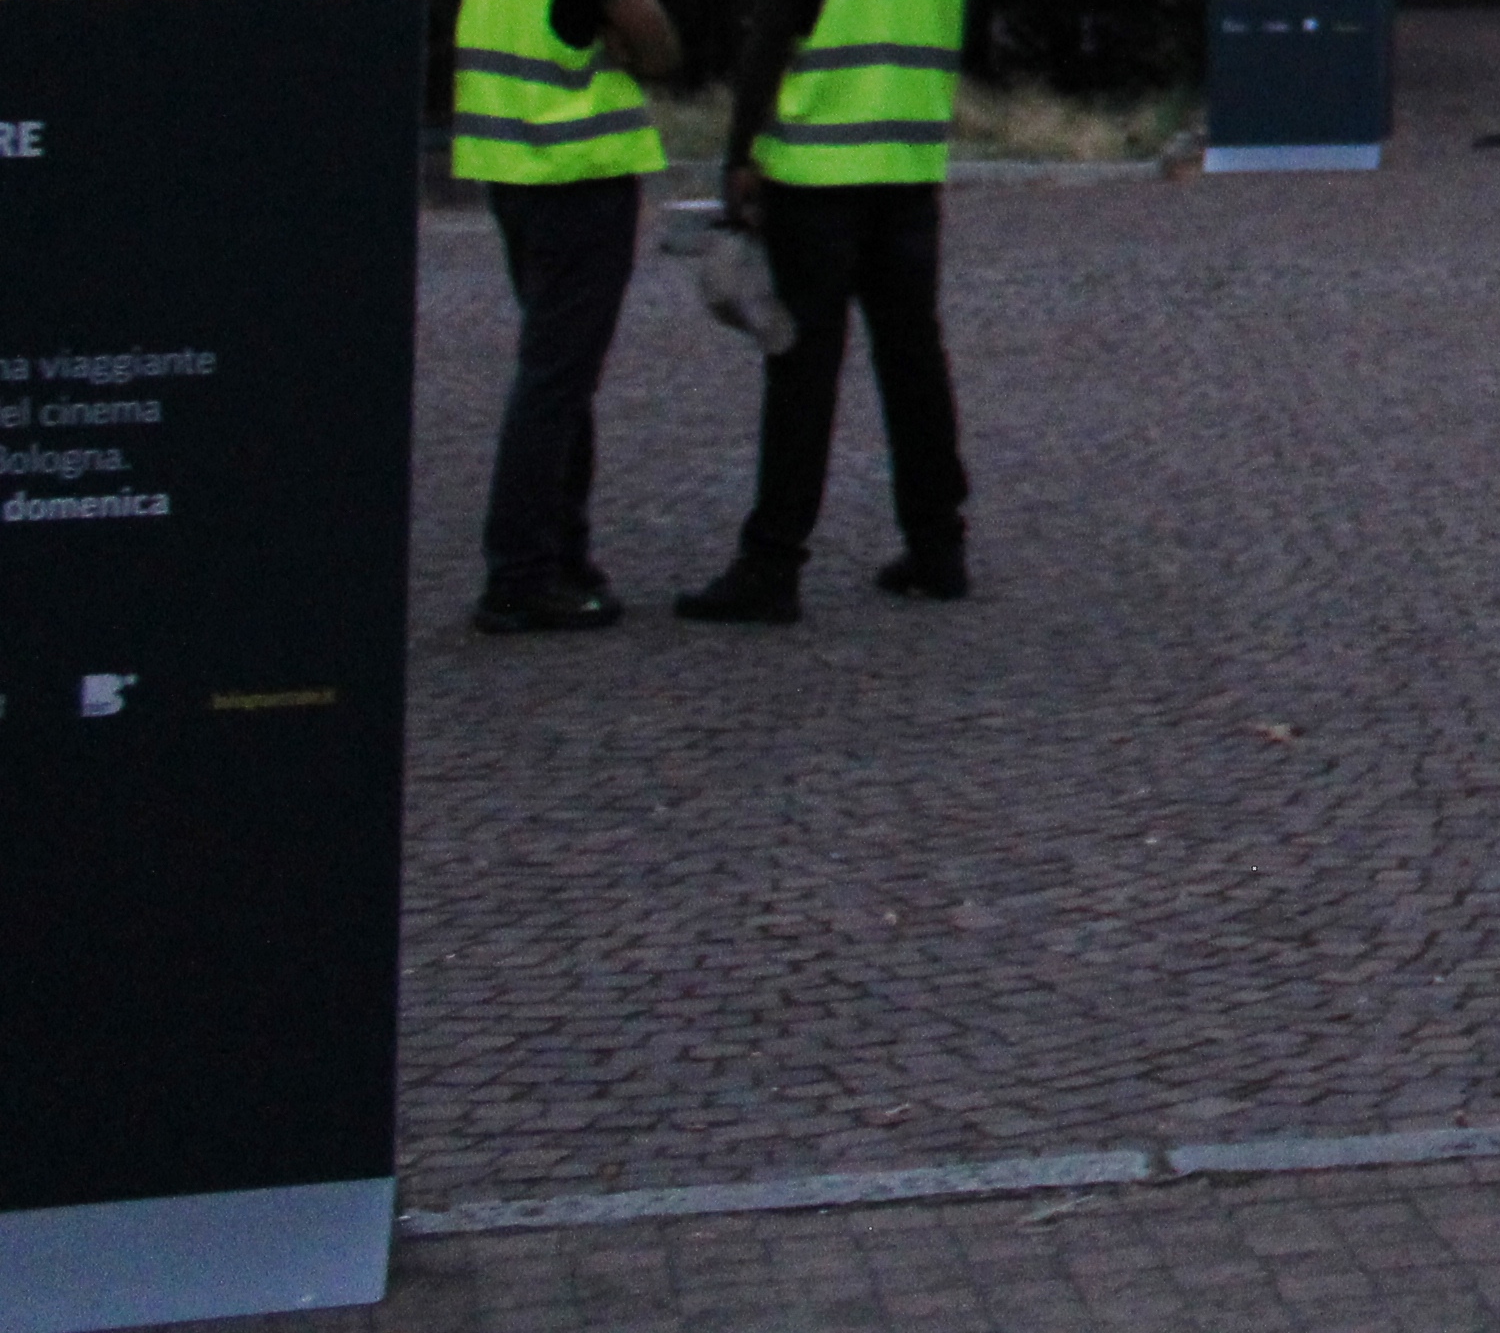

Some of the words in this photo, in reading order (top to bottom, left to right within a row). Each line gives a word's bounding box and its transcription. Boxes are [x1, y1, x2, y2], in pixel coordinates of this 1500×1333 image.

[37, 345, 217, 384] viaggiante
[38, 394, 162, 427] cinema
[3, 486, 170, 522] domenica
